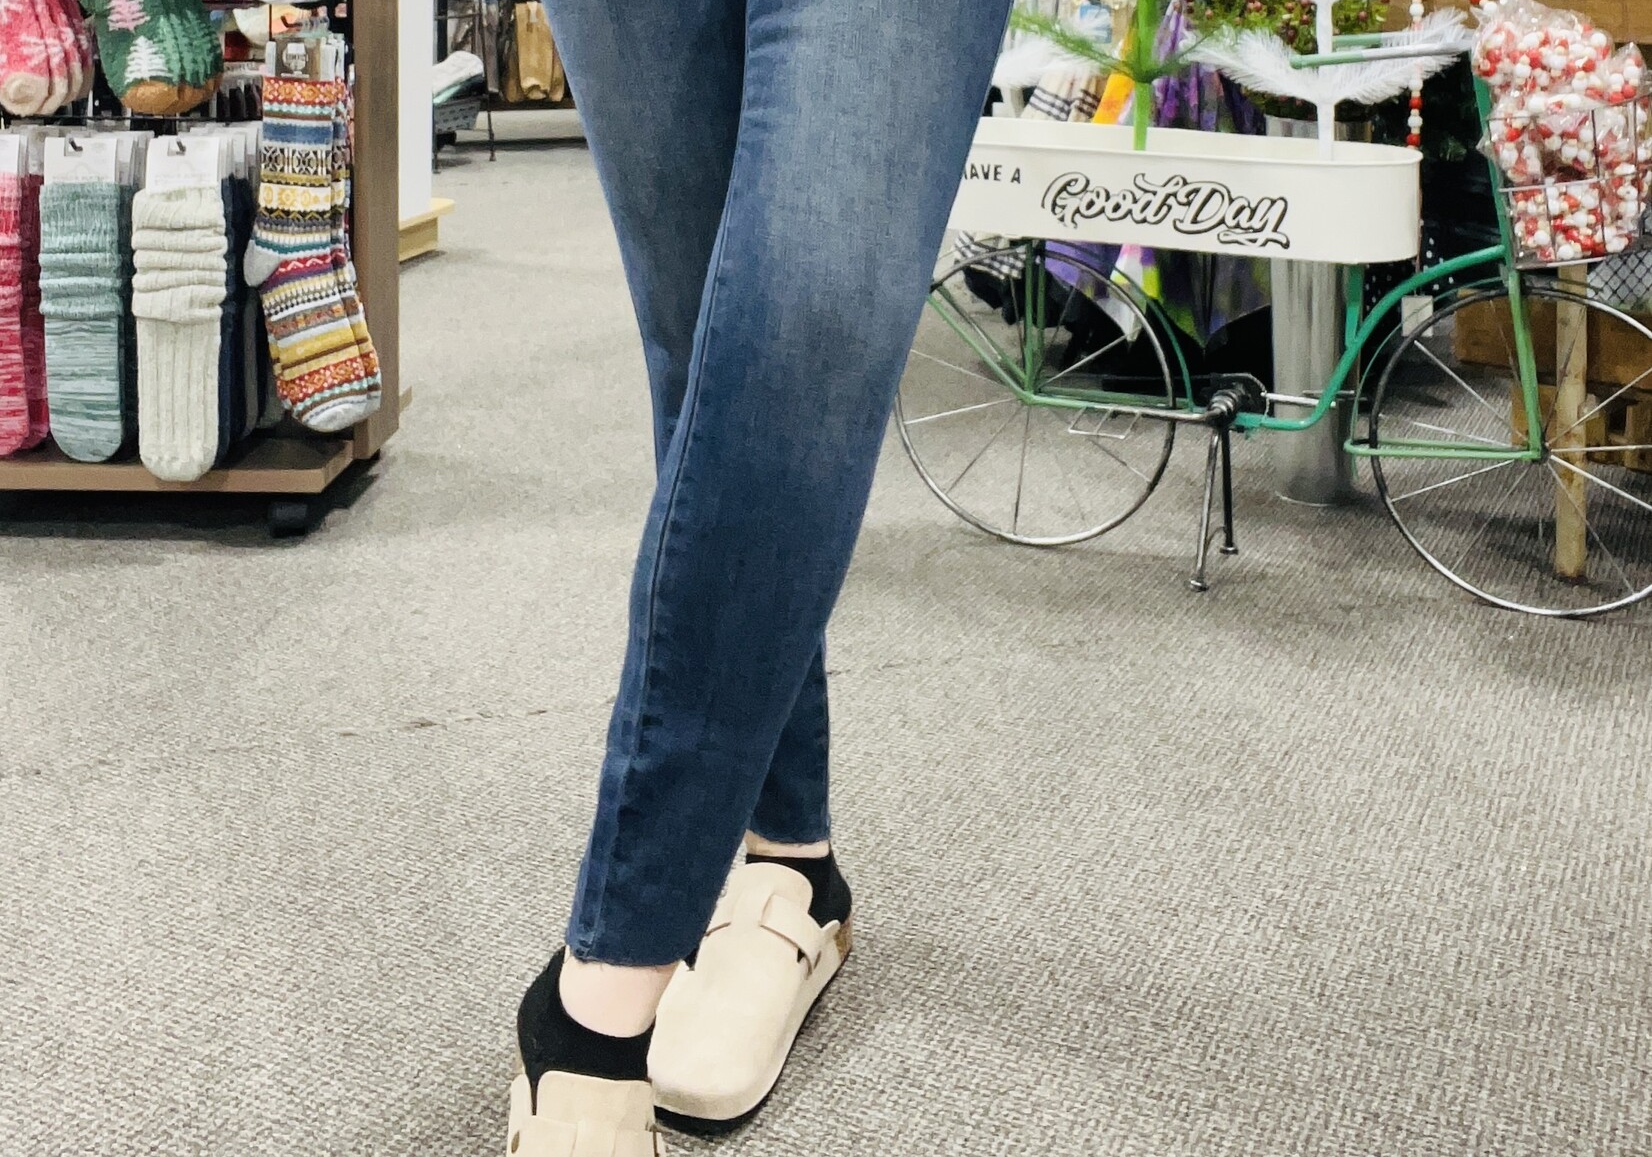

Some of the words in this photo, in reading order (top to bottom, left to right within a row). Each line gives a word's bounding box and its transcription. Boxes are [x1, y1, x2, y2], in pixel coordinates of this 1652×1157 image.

[1010, 167, 1021, 184] A
[1041, 171, 1187, 229] Good
[1173, 180, 1290, 249] Day
